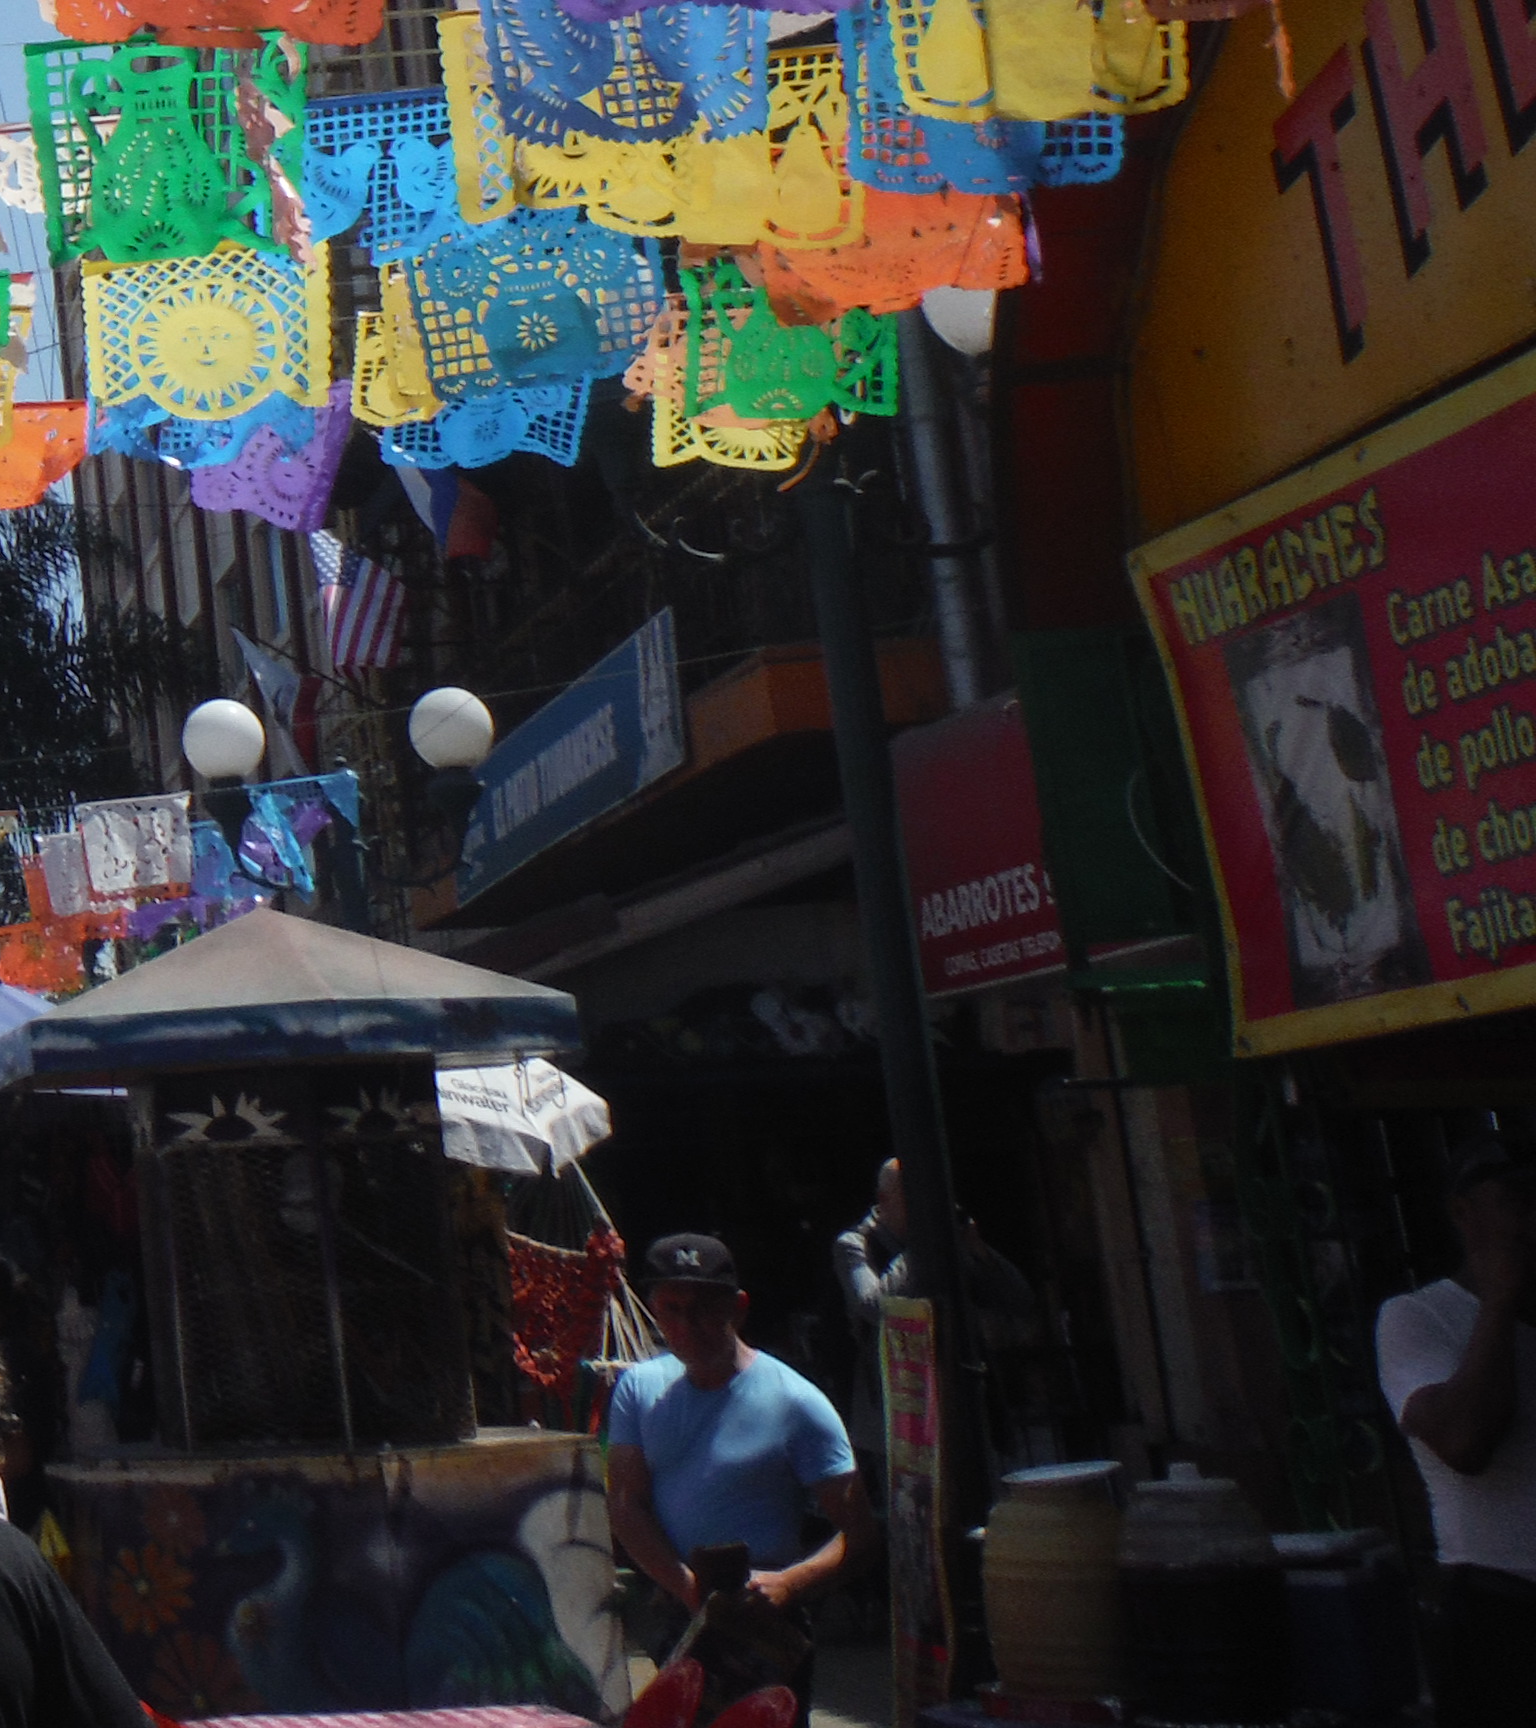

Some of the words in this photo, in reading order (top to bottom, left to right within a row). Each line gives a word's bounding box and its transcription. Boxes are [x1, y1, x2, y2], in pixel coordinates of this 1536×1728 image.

[1169, 486, 1387, 645] HUARACHES
[1387, 578, 1474, 645] Carne
[1403, 658, 1438, 717] de
[1446, 625, 1536, 703] adoba
[1417, 731, 1453, 791] de
[1460, 705, 1536, 791] pollo
[1433, 817, 1471, 875] de
[922, 863, 1040, 940] ABARROTES
